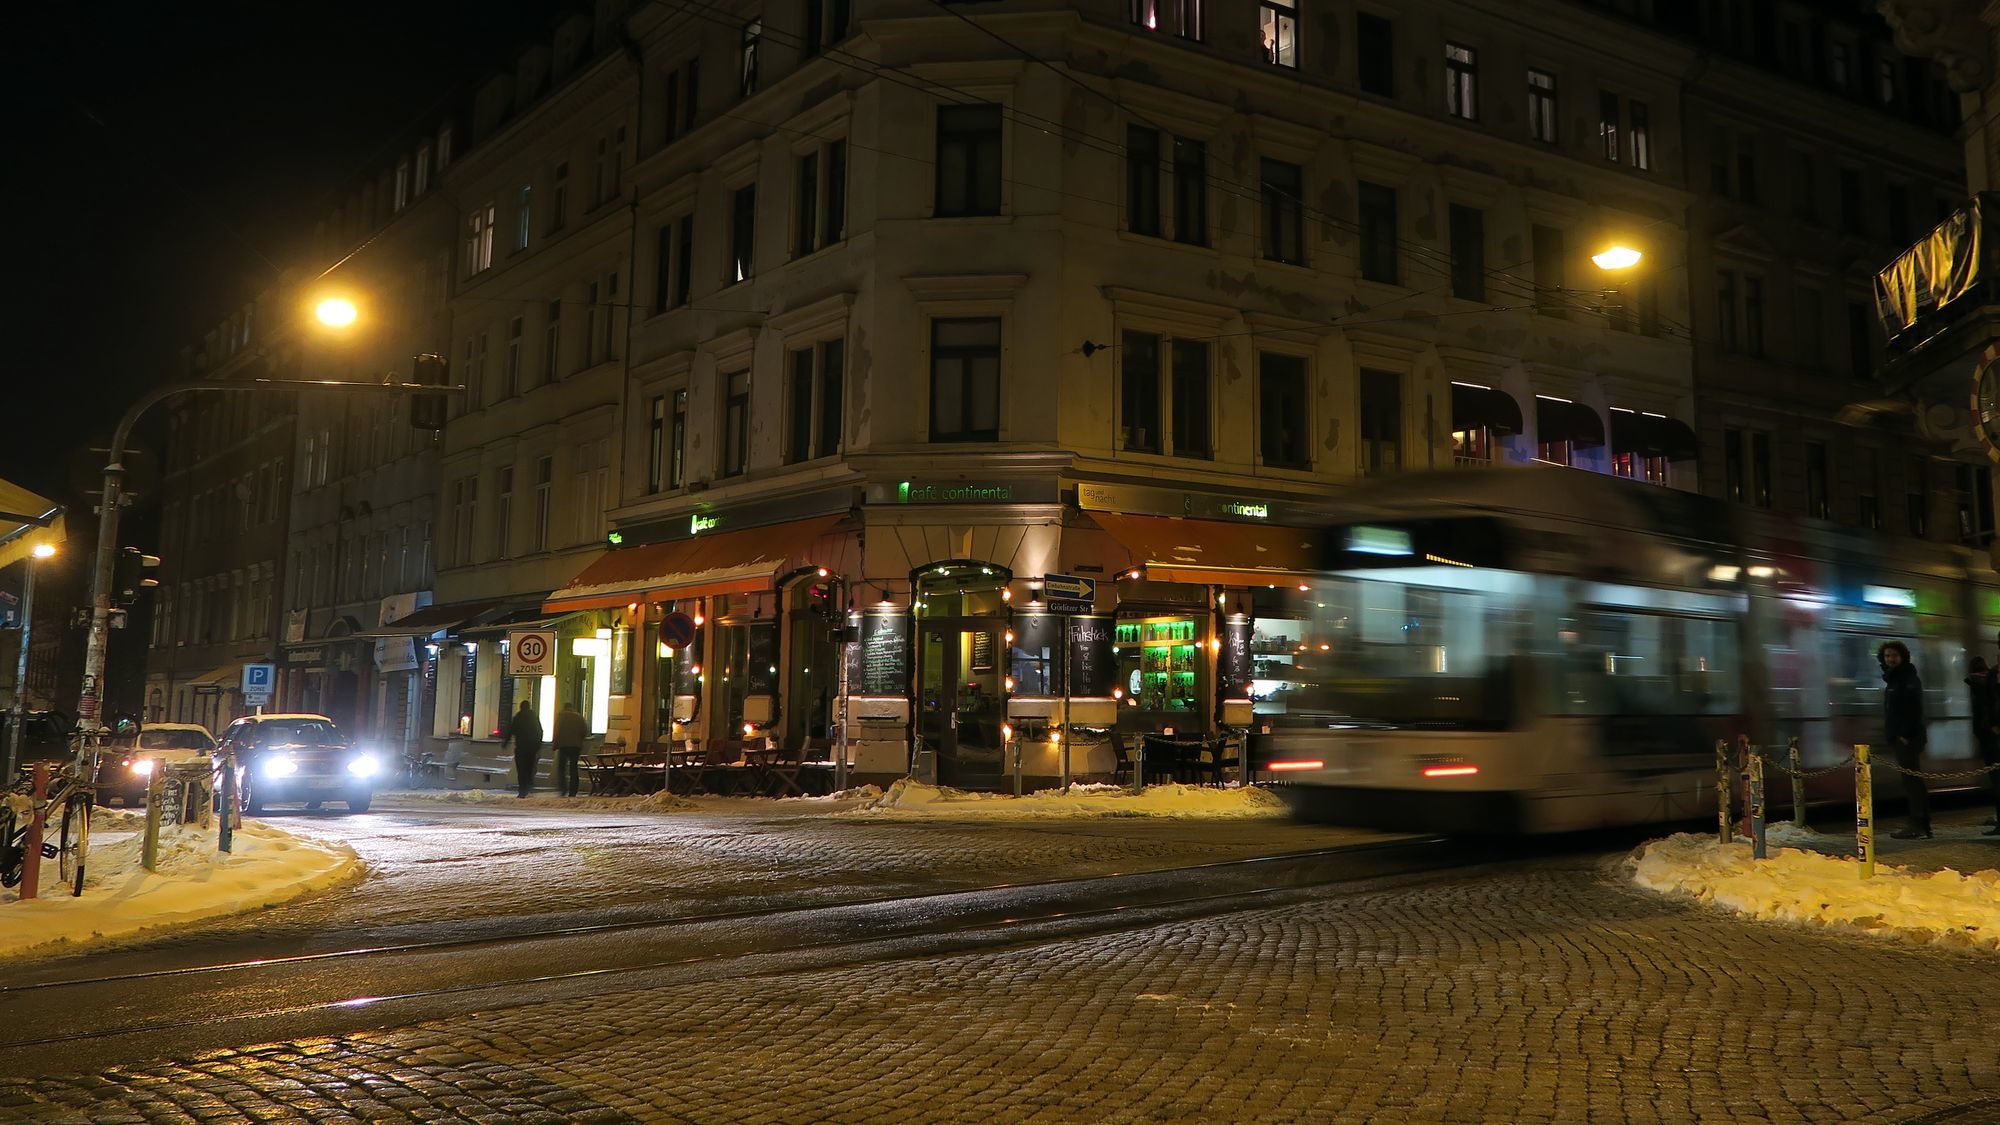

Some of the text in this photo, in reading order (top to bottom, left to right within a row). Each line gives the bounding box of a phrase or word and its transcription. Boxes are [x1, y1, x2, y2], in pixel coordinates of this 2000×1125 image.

[911, 485, 1012, 500] café continental
[1083, 487, 1095, 499] tag
[1095, 494, 1116, 504] nacht
[1050, 602, 1078, 612] Görlitzer
[523, 642, 541, 656] 30
[520, 665, 543, 673] ZONE
[253, 669, 264, 683] P
